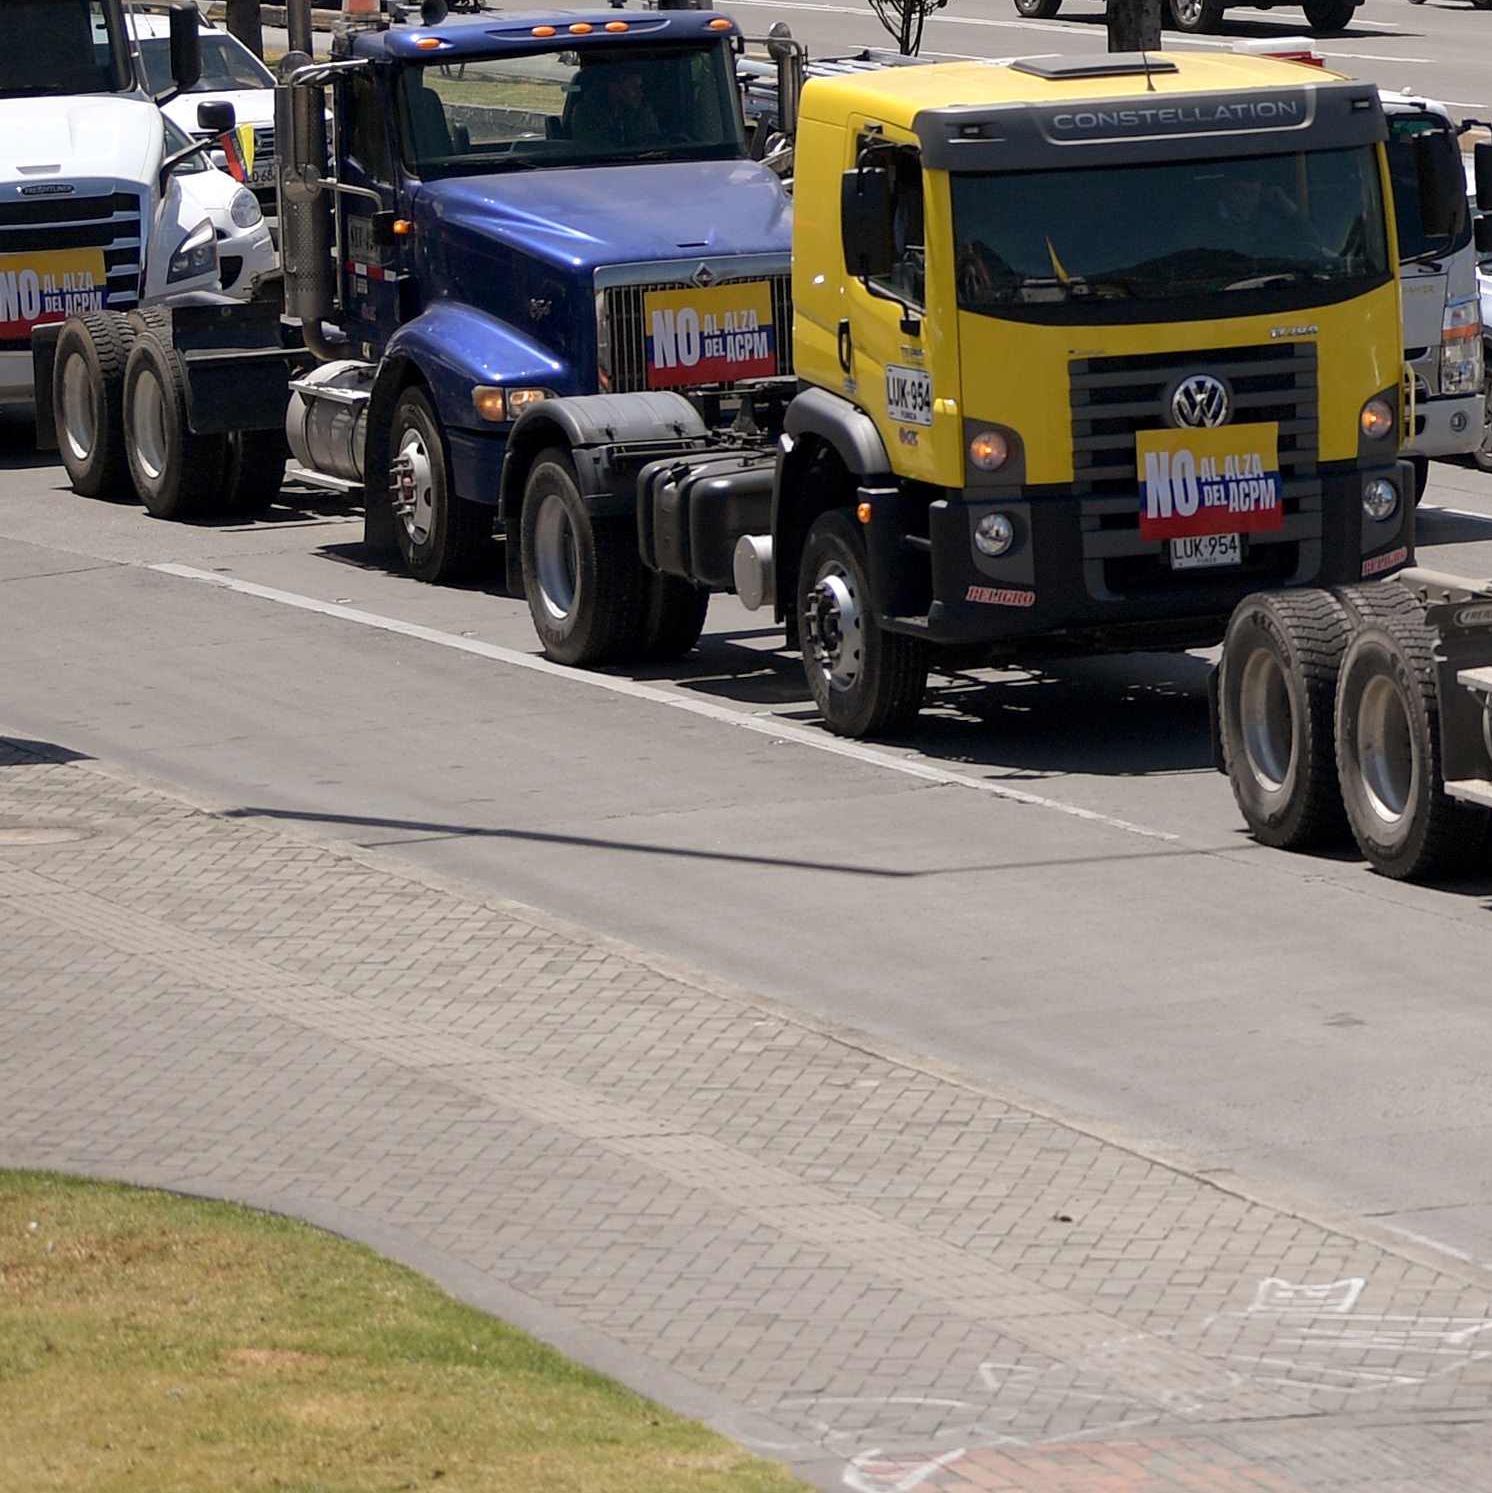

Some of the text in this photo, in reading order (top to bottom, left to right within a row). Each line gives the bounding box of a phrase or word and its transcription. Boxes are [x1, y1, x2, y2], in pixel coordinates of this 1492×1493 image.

[1053, 100, 1298, 130] CONSTELLATION
[0, 269, 41, 321] NO
[43, 271, 95, 295] AL ALZA
[44, 292, 103, 317] DEL ACPM
[652, 308, 701, 368] NO
[704, 309, 759, 337] AL ALZA
[705, 331, 768, 362] DEL ACPM
[1201, 453, 1265, 483] AL ALZA
[1144, 449, 1199, 519] NO
[1203, 478, 1276, 513] DEL ACPM
